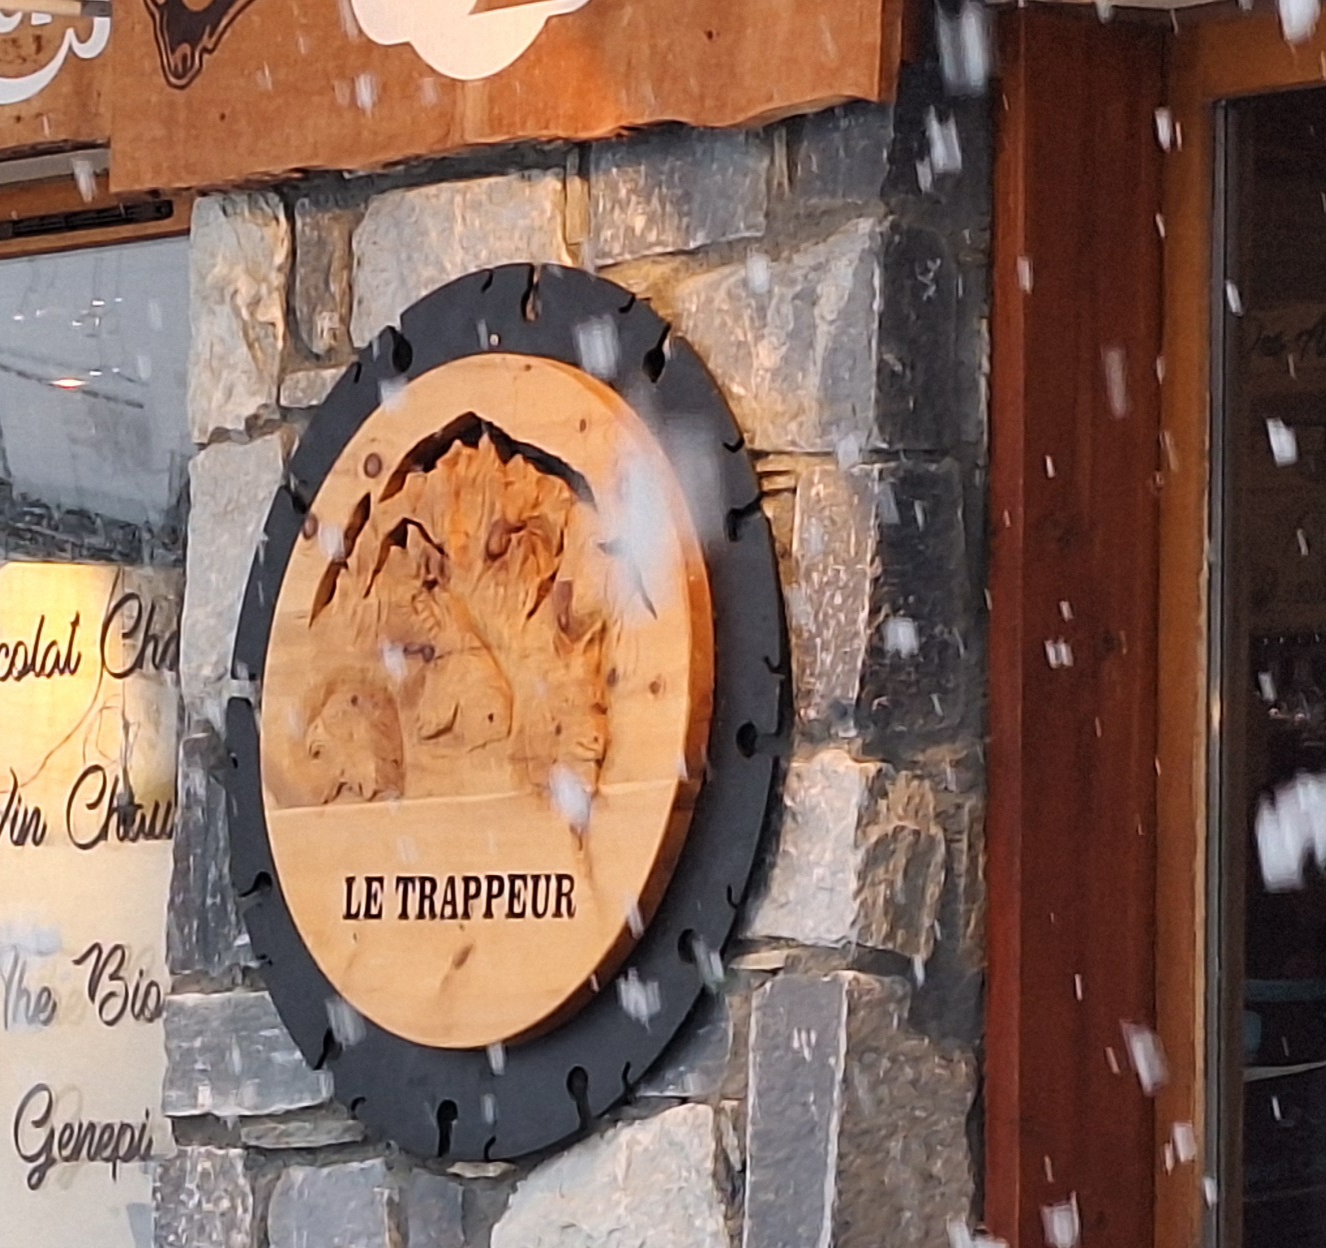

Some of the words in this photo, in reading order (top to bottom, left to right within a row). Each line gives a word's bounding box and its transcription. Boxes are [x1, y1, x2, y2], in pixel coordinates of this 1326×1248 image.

[342, 876, 384, 921] LE
[395, 873, 577, 921] TRAPPEUR
[72, 942, 165, 1027] Bio
[14, 1083, 154, 1190] Genepi
